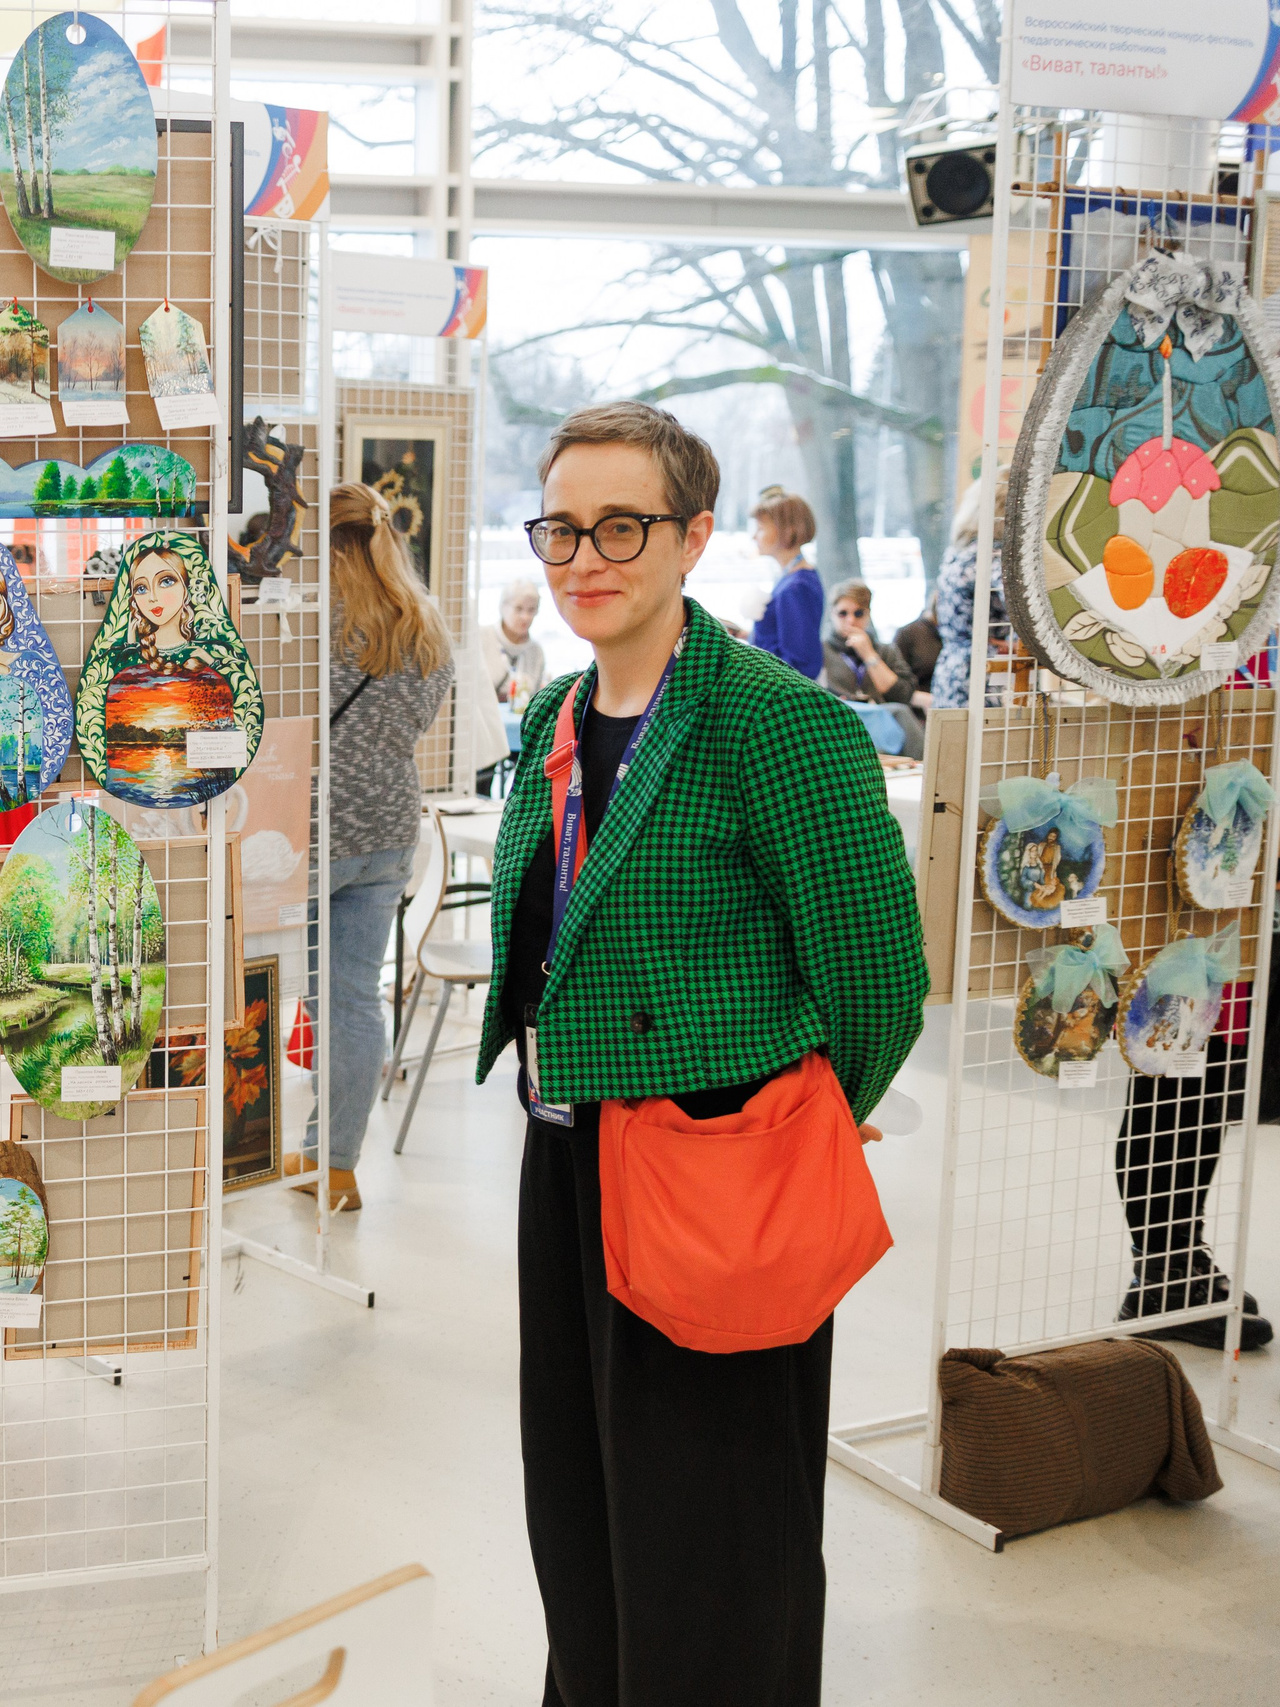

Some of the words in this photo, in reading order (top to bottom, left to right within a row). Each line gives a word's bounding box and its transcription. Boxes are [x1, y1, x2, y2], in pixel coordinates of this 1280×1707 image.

[1024, 15, 1108, 33] Всероссийский
[1109, 24, 1166, 40] творческий
[1022, 36, 1108, 51] педагогических
[1109, 40, 1167, 56] работников
[1021, 54, 1085, 77] «Виват,
[1090, 61, 1169, 80] таланты!»
[562, 812, 578, 845] Виват,
[558, 845, 572, 892] таланты!
[533, 1106, 565, 1122] УЧАСТНИК
